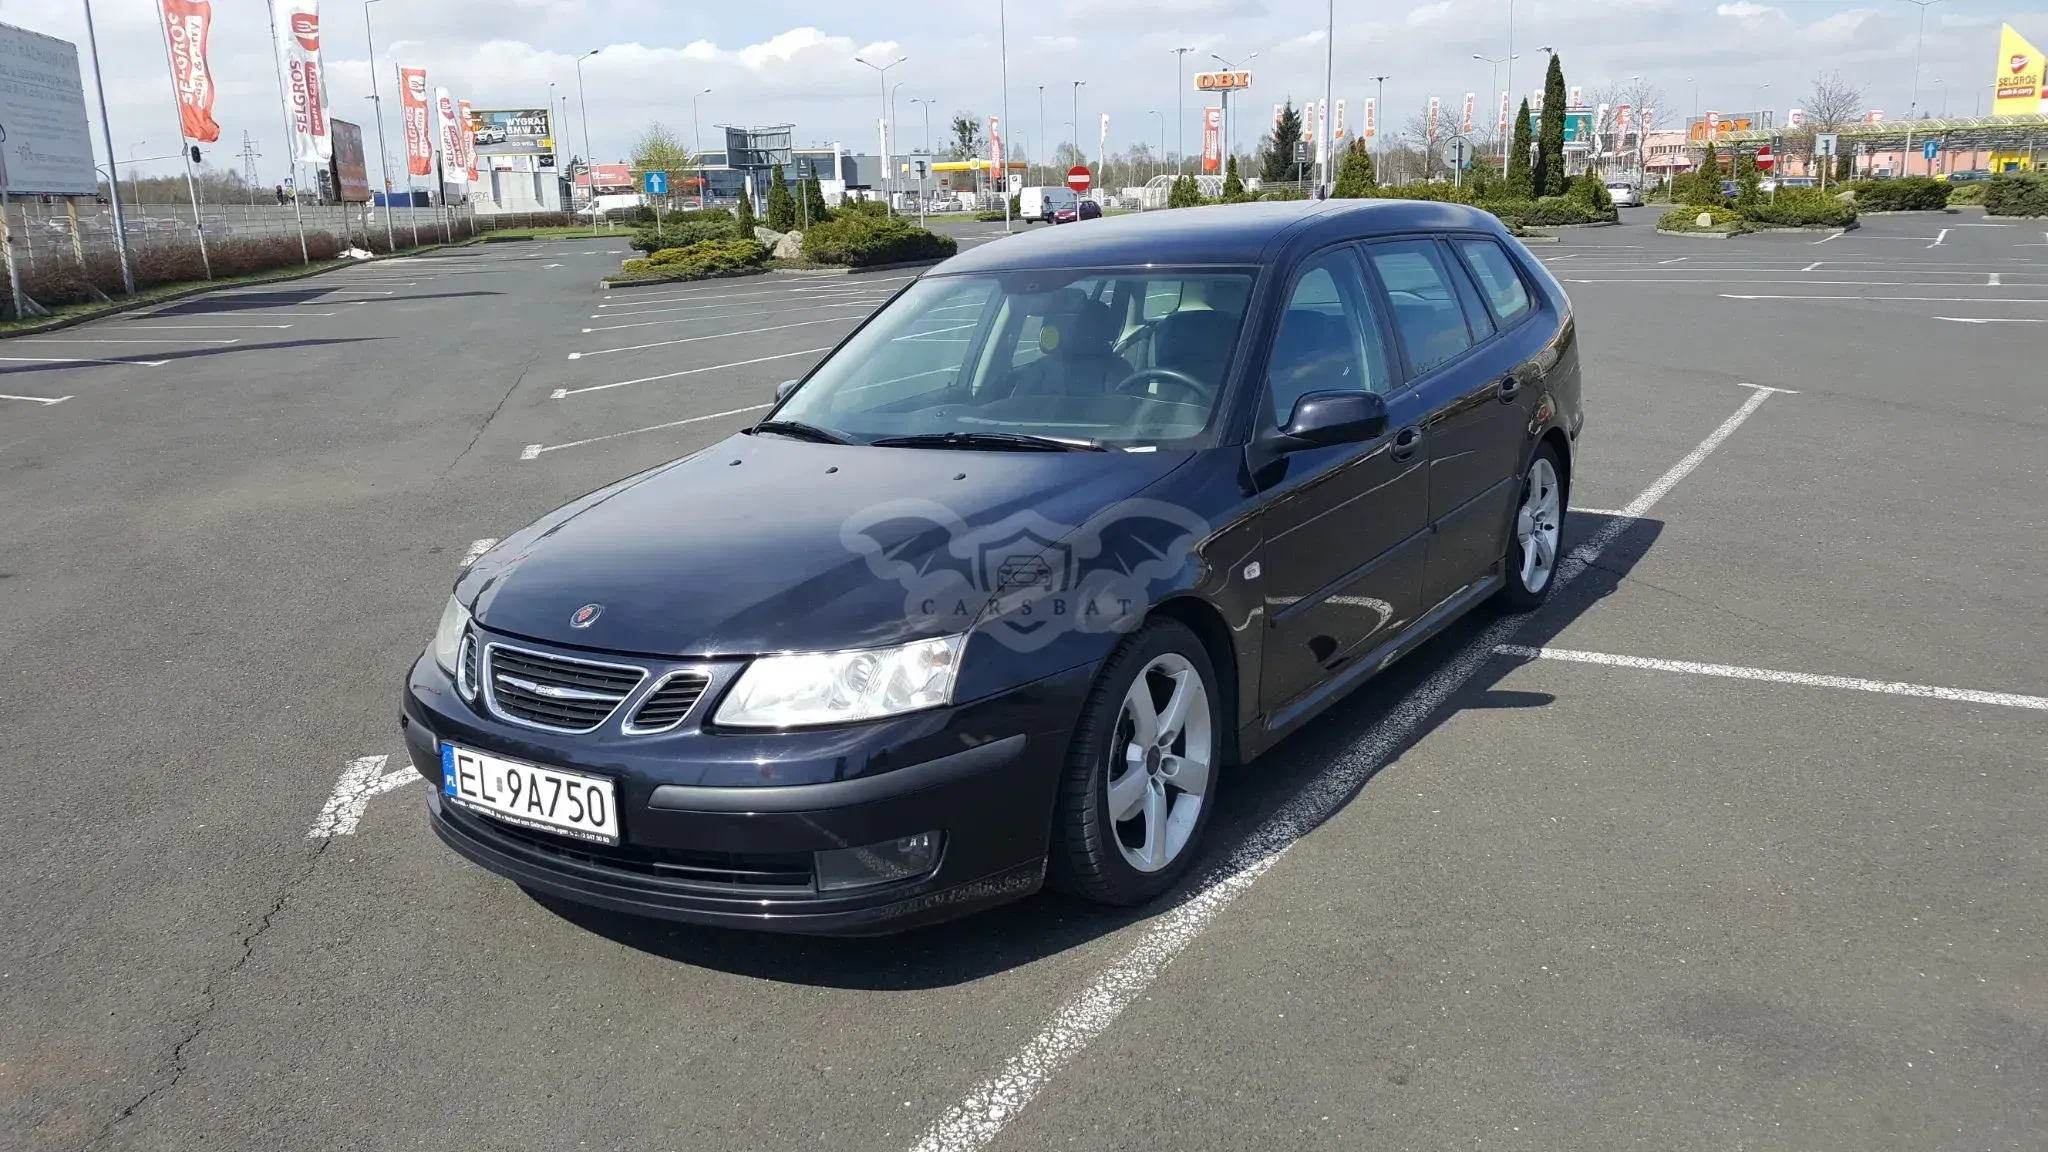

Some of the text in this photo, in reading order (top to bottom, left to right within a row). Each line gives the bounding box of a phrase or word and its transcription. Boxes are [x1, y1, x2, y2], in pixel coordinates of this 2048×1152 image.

[306, 65, 317, 95] carry
[1197, 73, 1249, 89] OBI
[1998, 75, 2037, 87] SELGROS
[289, 60, 308, 134] SELGROS
[506, 117, 546, 126] WYGRAJ
[507, 125, 546, 134] BMW X1
[405, 106, 418, 157] SELGROS
[446, 775, 456, 788] PL
[457, 754, 606, 827] EL 9A750
